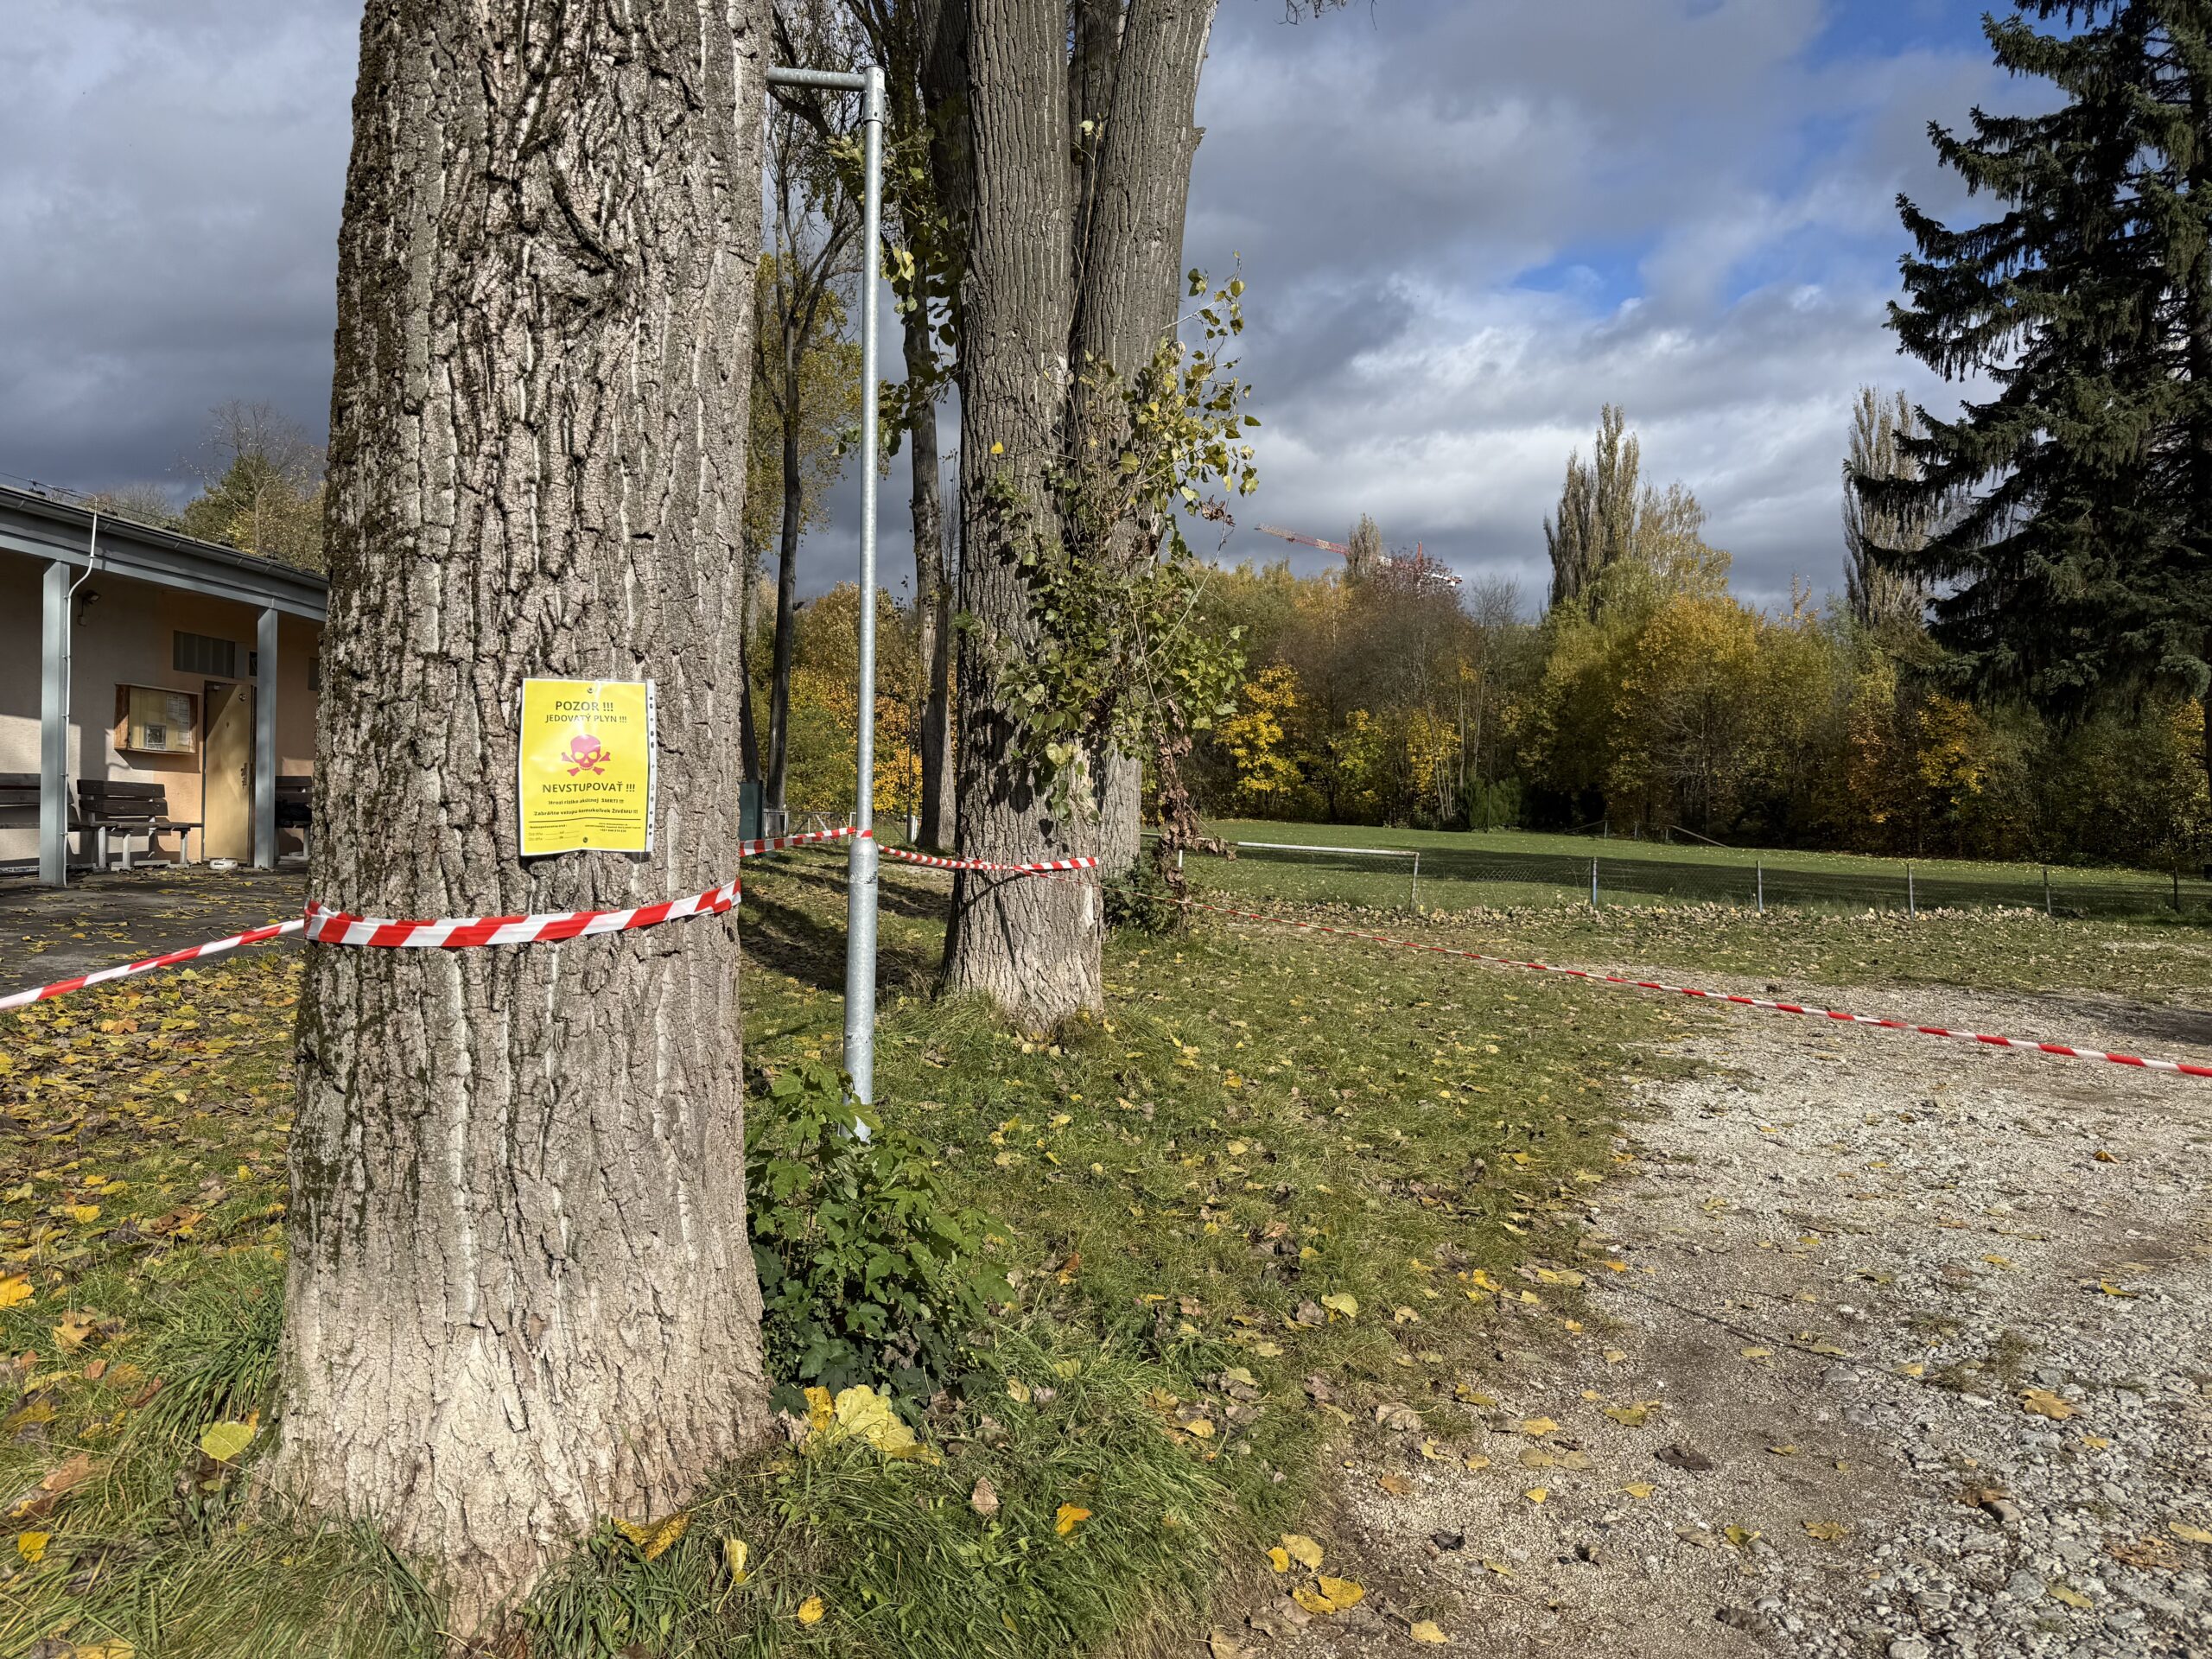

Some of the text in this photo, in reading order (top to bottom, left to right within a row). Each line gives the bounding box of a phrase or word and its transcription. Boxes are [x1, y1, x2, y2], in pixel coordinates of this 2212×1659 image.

[556, 701, 613, 712] POZOR !!!
[545, 713, 591, 723] JEDOVATÝ
[543, 781, 636, 793] NEVSTUPOVAŤ !!!
